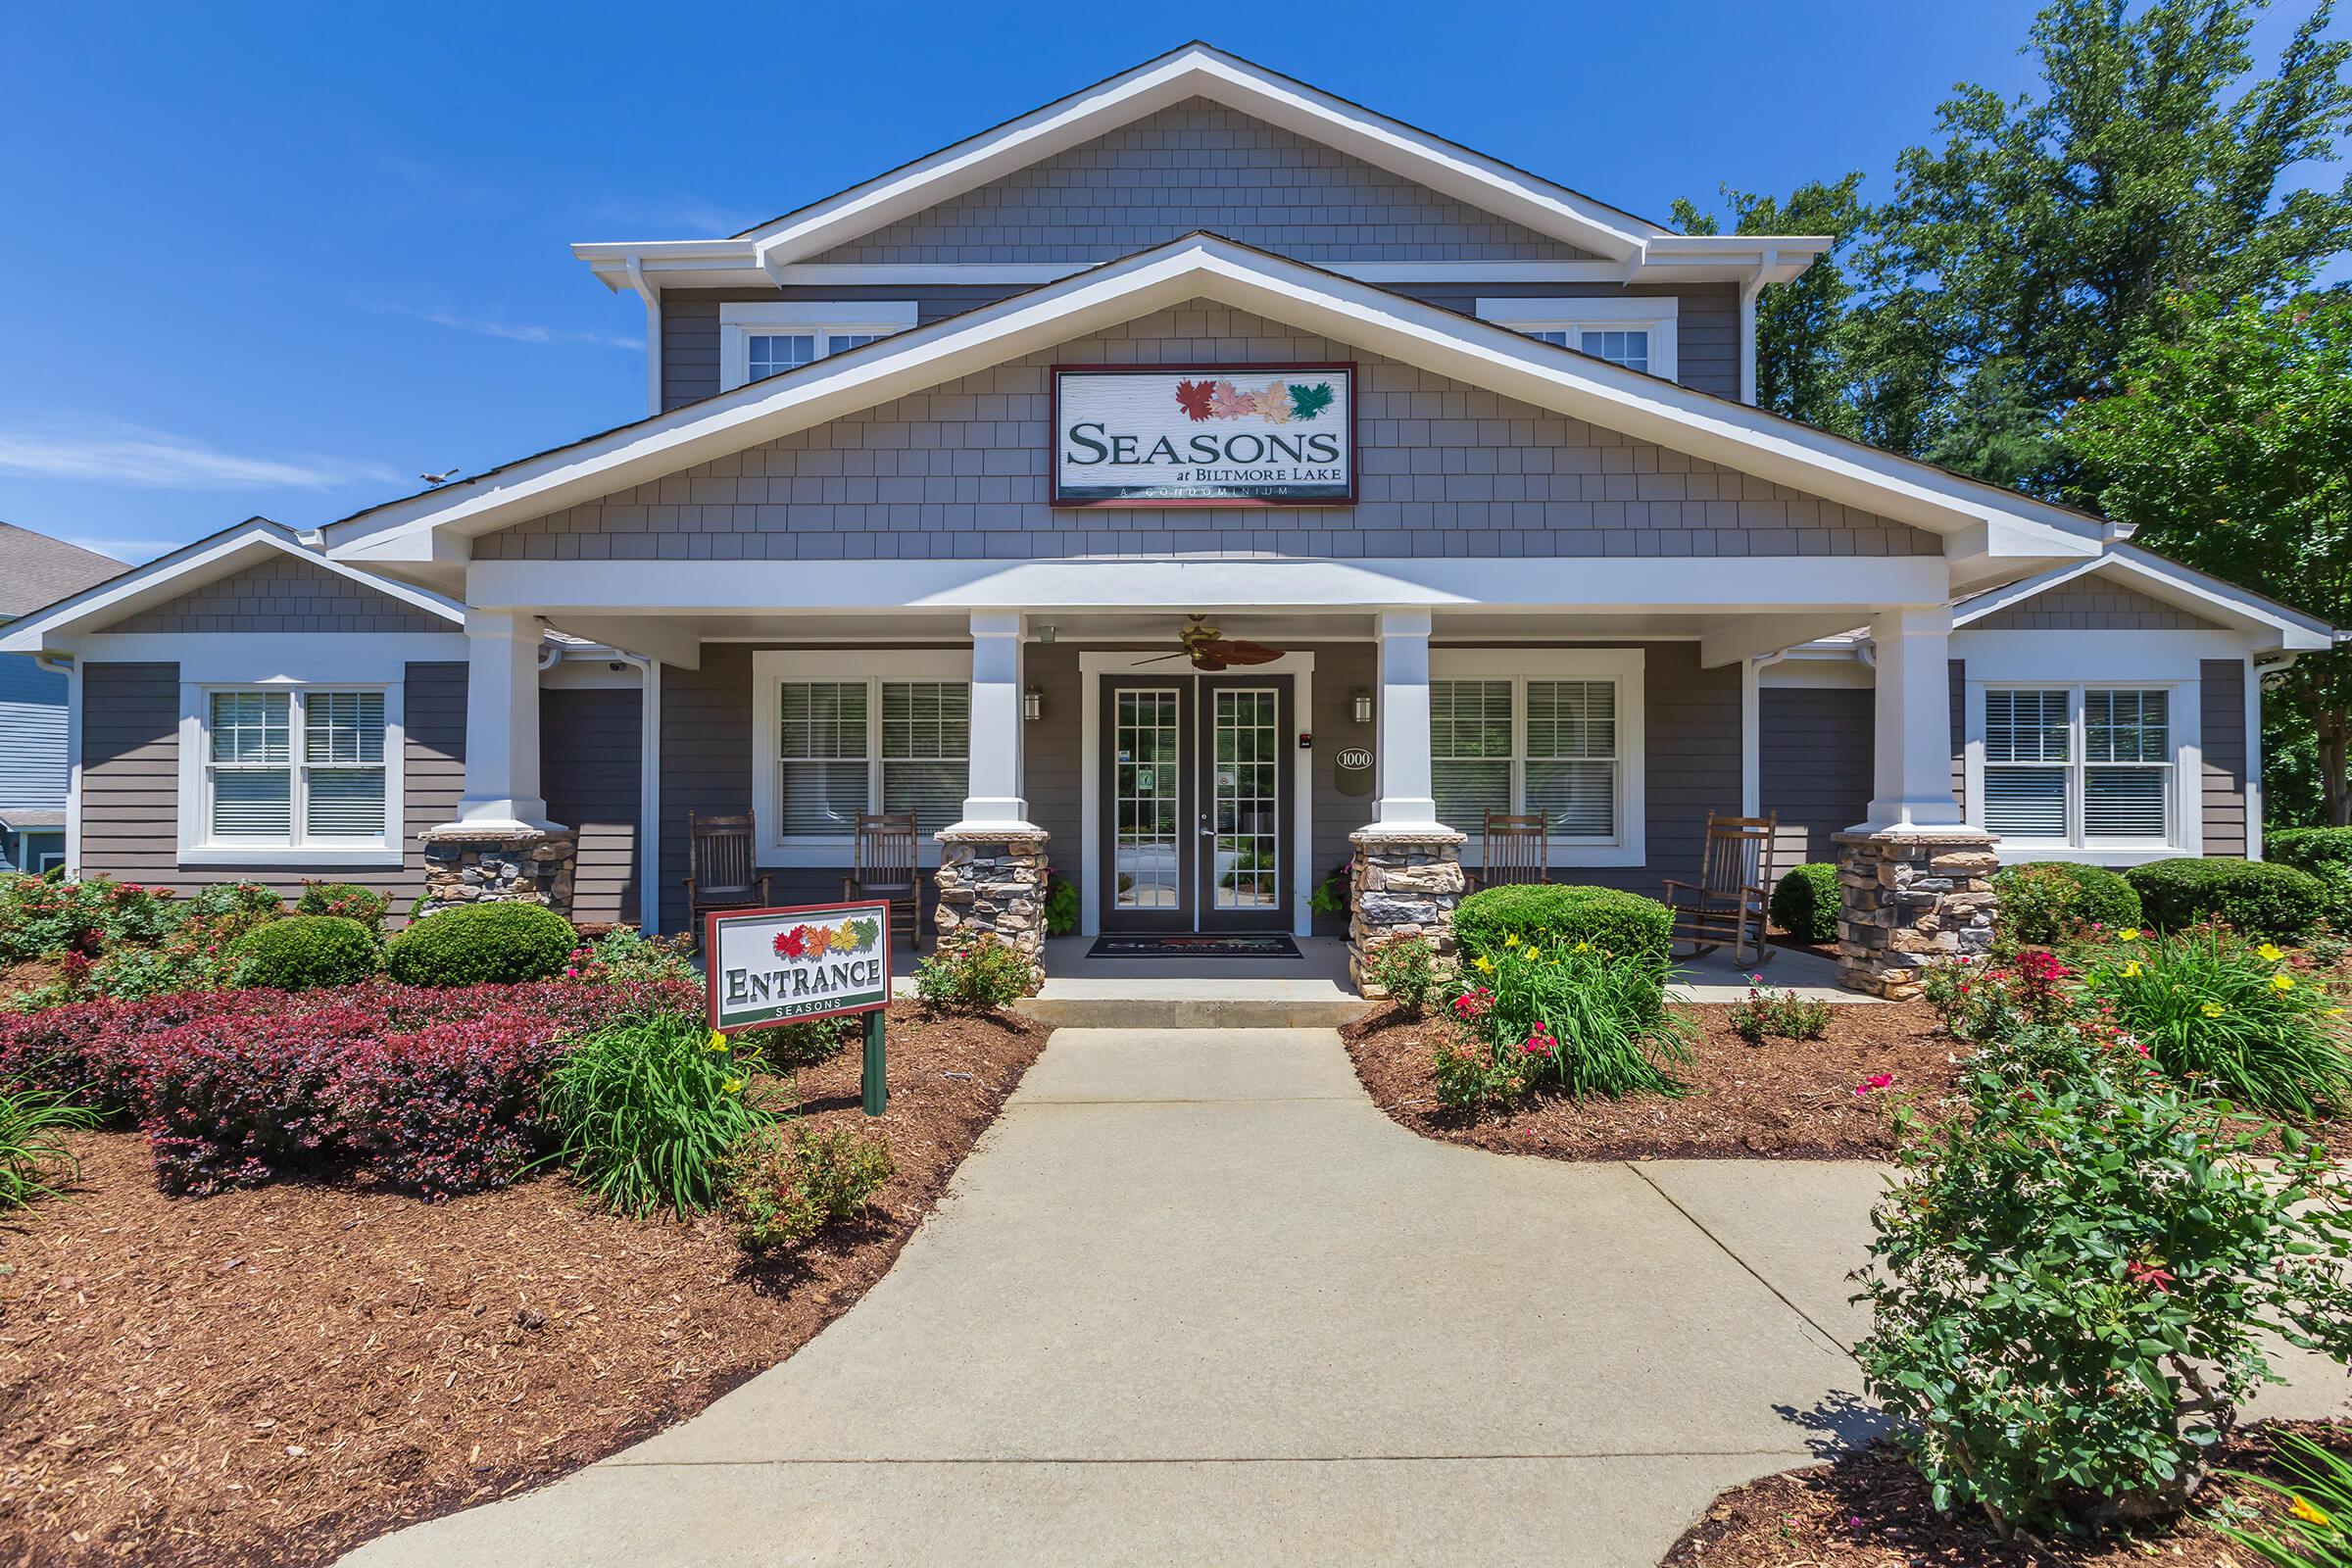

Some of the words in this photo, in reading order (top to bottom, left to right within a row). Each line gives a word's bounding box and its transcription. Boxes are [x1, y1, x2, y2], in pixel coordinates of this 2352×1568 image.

[1066, 422, 1341, 466] SEASONS
[1176, 471, 1191, 481] at
[1196, 468, 1286, 481] BILTMORE
[1293, 467, 1342, 480] LAKE
[1119, 488, 1128, 497] A
[1145, 487, 1288, 497] CONDOMINIUM
[1342, 752, 1370, 765] 1000
[726, 958, 881, 1004] ENTRANCE
[775, 999, 842, 1017] SEASONS
